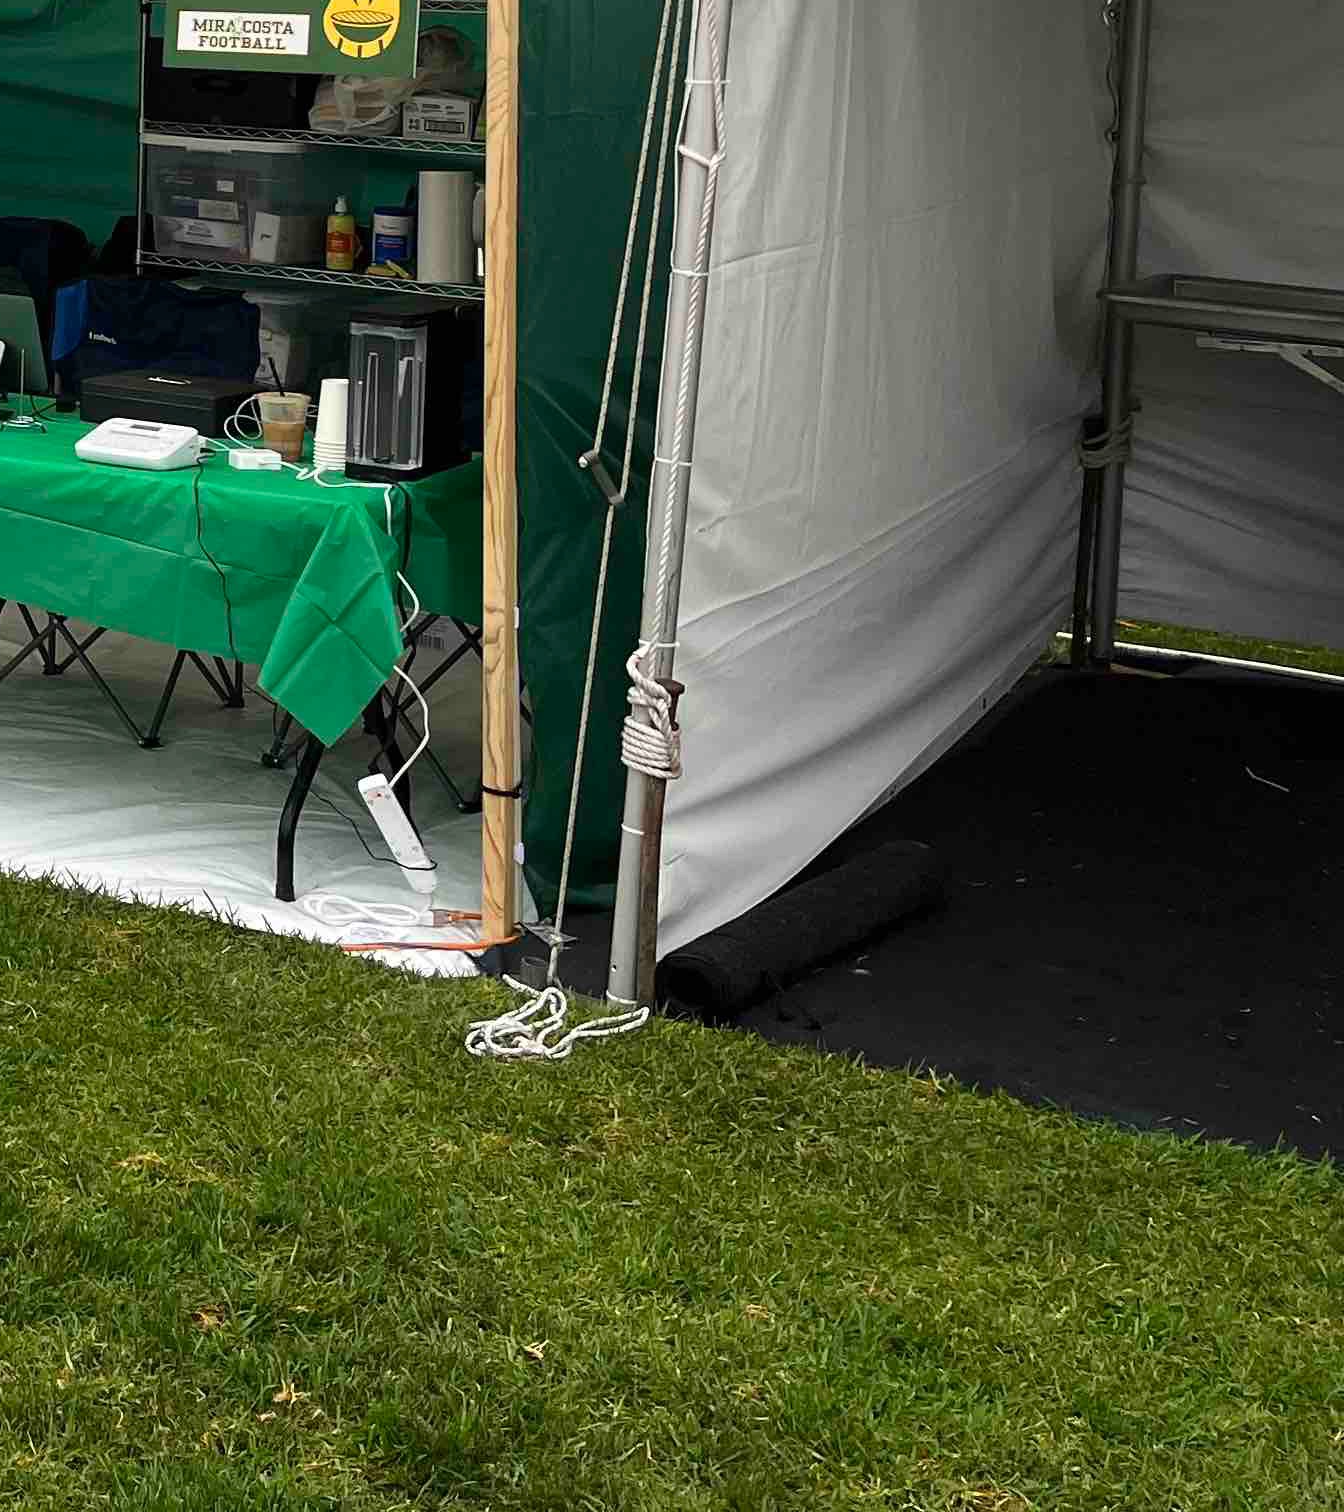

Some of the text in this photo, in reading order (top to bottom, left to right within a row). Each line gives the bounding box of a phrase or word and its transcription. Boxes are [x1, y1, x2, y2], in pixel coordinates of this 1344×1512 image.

[192, 18, 294, 34] MIRA COSTA
[198, 35, 287, 50] FOOTBALL
